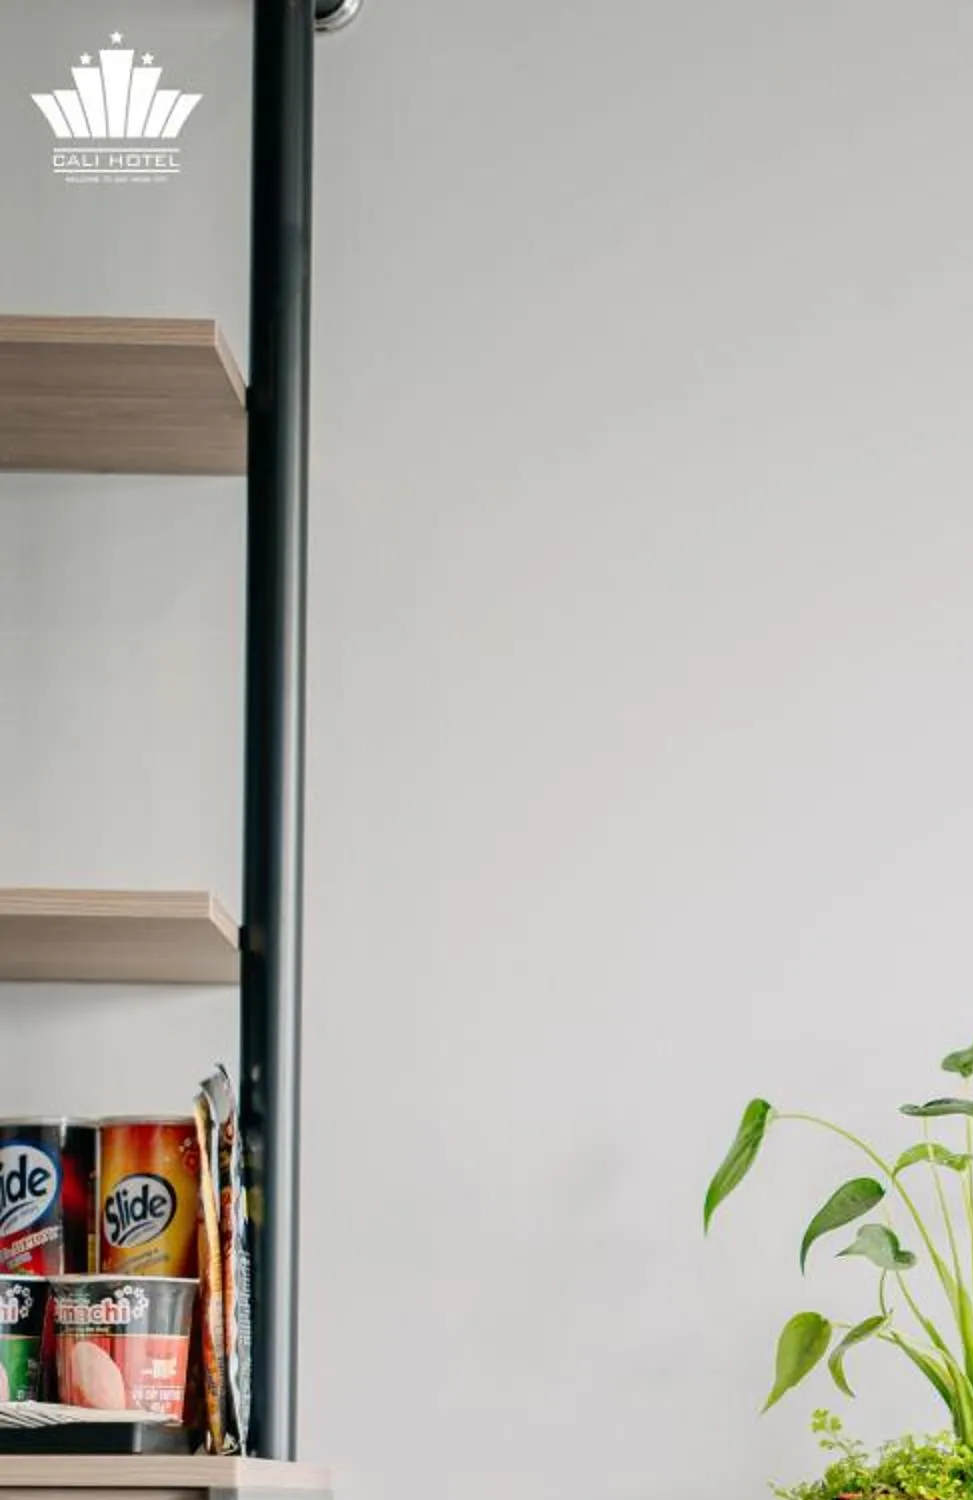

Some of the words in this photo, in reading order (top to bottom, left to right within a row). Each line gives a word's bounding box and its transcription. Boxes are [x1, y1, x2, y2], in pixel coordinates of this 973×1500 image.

[0, 1154, 51, 1210] ide
[105, 1184, 167, 1242] Slide
[54, 1298, 131, 1324] machi
